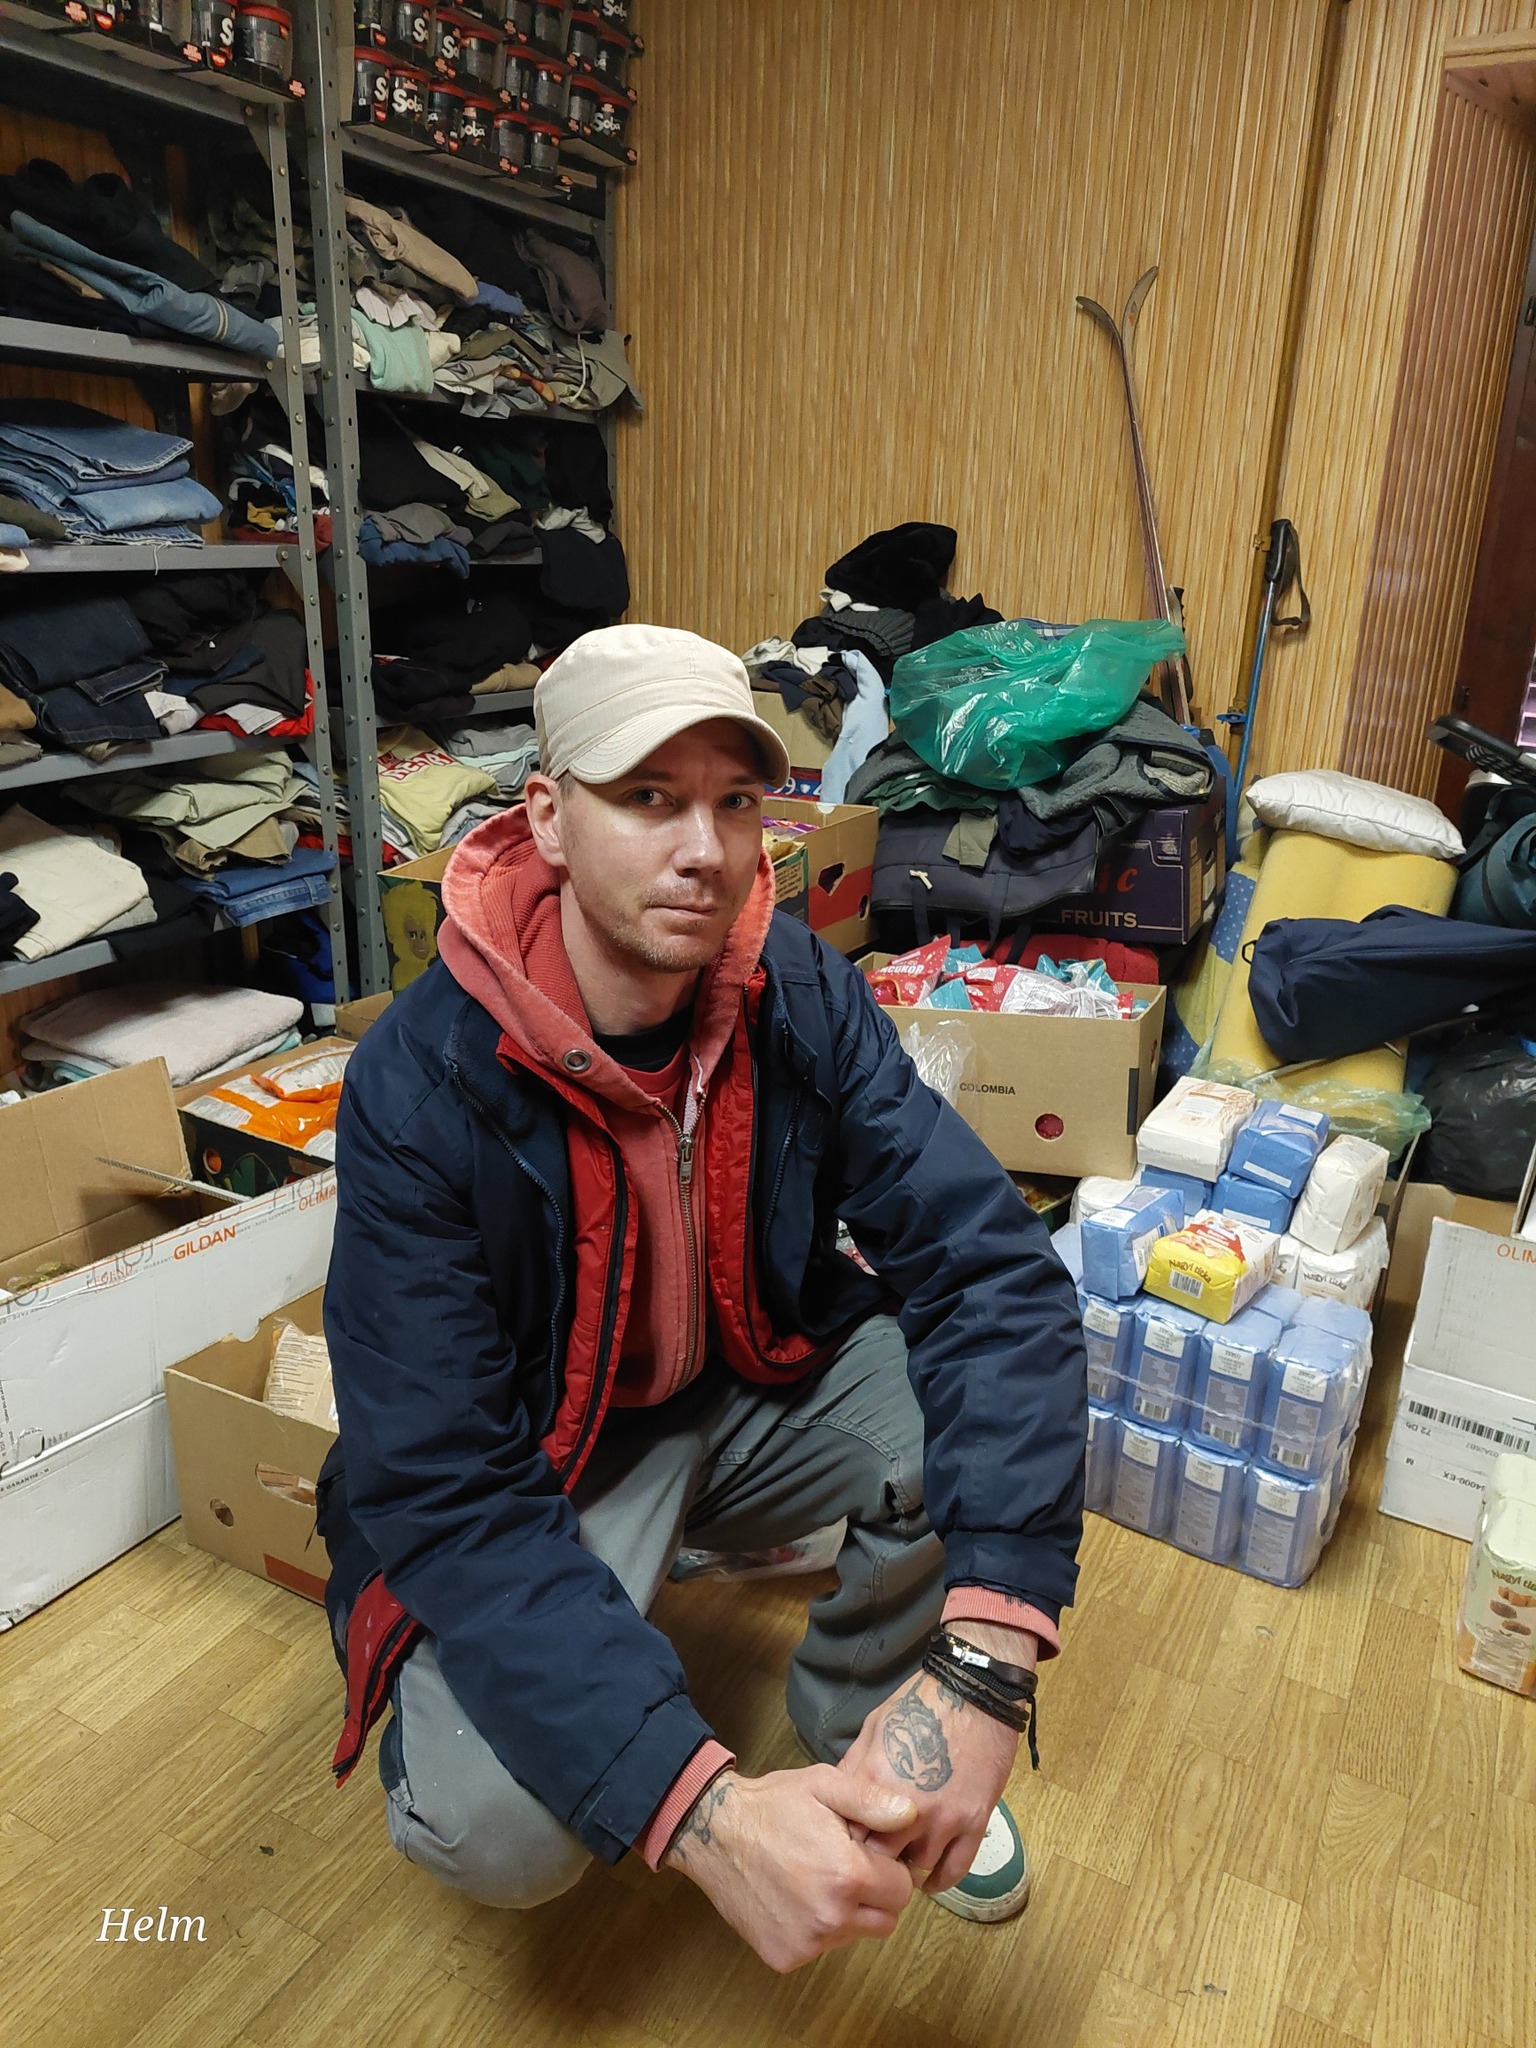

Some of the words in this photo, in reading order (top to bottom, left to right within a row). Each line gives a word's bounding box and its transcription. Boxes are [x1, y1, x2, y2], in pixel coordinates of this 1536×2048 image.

[391, 88, 423, 113] Soba
[590, 112, 621, 134] Soba
[1060, 909, 1138, 929] FRUITS
[959, 1082, 1016, 1096] COLOMBIA
[173, 1225, 237, 1261] GILDAN
[1405, 1456, 1415, 1466] M
